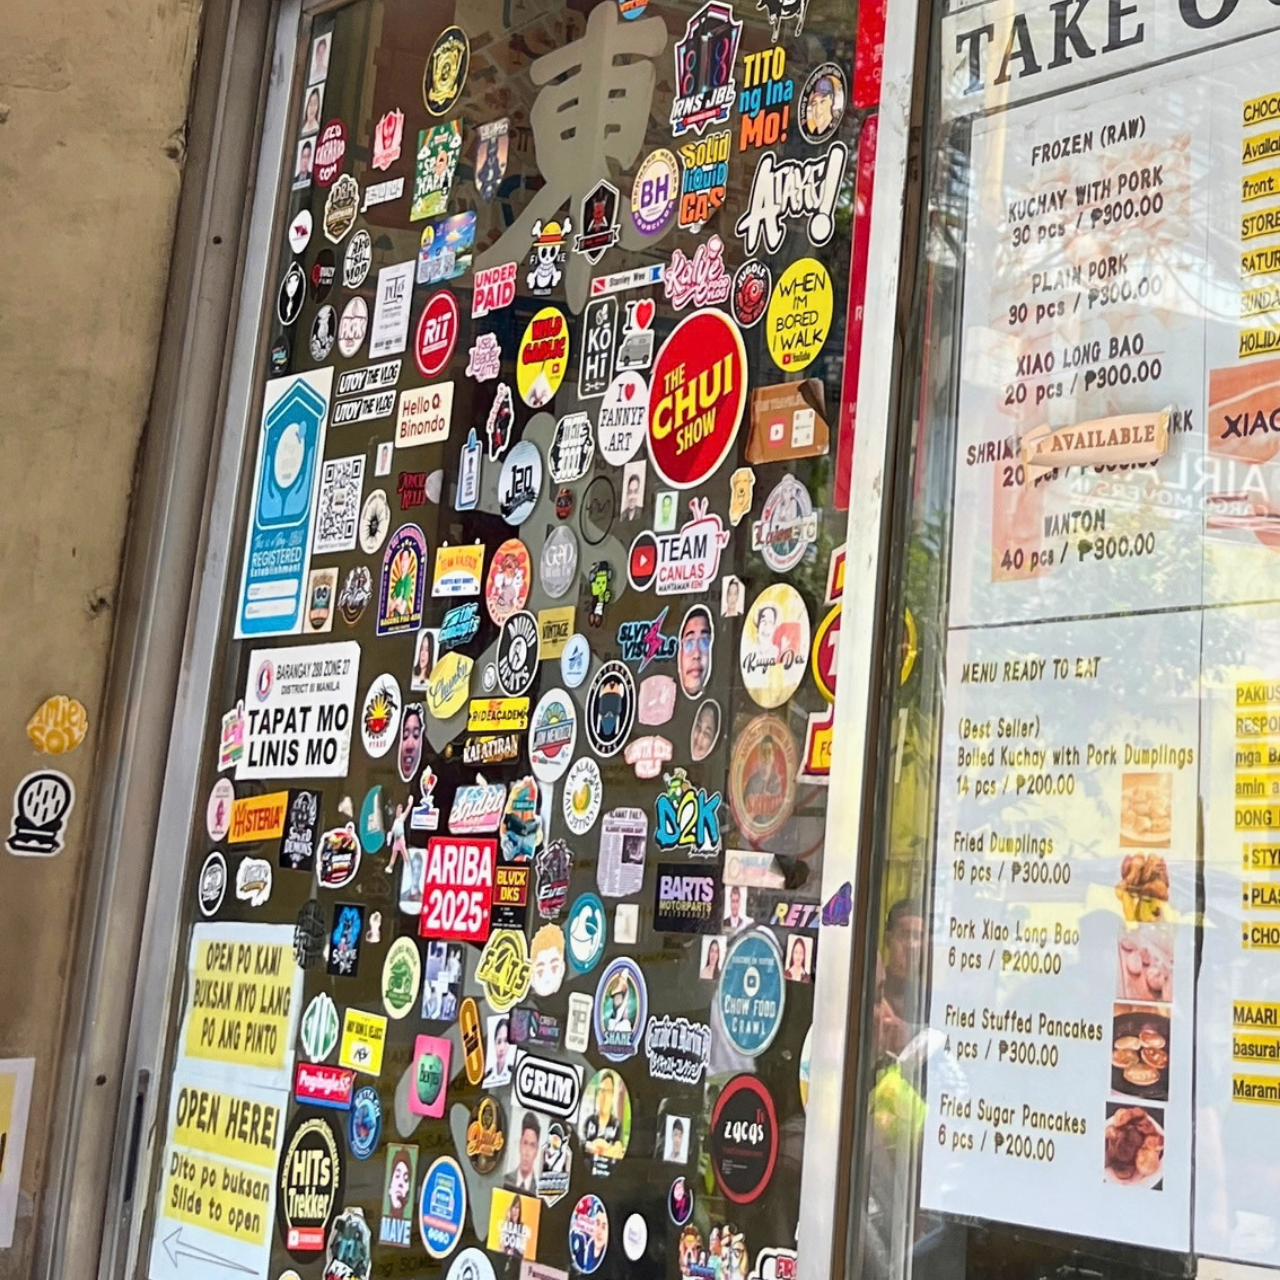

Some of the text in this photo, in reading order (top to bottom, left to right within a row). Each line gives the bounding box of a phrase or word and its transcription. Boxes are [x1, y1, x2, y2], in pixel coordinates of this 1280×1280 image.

[744, 47, 786, 88] TITO
[738, 79, 794, 116] ng Ina
[1031, 116, 1146, 166] FROZEN (RAW)
[1008, 165, 1163, 223] KUCHAY WITH PORK
[1242, 178, 1274, 198] front
[475, 263, 517, 288] UNDER
[779, 272, 826, 297] WHEN
[473, 282, 515, 313] PAID
[776, 311, 818, 332] BORED
[781, 328, 823, 351] WALK
[340, 364, 398, 393] UTOY THE VLOG
[664, 362, 685, 394] THE
[402, 396, 429, 417] Hello
[652, 353, 733, 440] CHUI
[400, 414, 445, 438] Binondo
[676, 410, 716, 455] SHOW
[1051, 425, 1155, 452] AVAILABLE
[660, 534, 707, 562] TEAM
[660, 563, 704, 582] CANLAS
[961, 656, 1101, 683] MENU READY TO EAT
[249, 704, 349, 735] TAPAT MO
[959, 715, 1040, 739] (Best Seller)
[248, 737, 337, 767] LINIS MO
[1001, 745, 1046, 768] Kuchay
[1053, 747, 1080, 764] with
[1087, 744, 1116, 764] Pork
[1125, 744, 1194, 769] Dumplings
[656, 791, 721, 846] D2K
[426, 844, 492, 887] ARIBA
[660, 876, 714, 901] BARTS
[660, 901, 712, 912] MOTORPARTS
[206, 942, 282, 975] OPEN PO KAMI
[194, 979, 290, 1017] BUKSAN NYO LANG
[724, 995, 775, 1018] CHOW FOOD
[732, 1020, 766, 1035] CRAWL
[945, 1004, 1103, 1041] Fried Stuffed Pancakes
[1233, 1007, 1277, 1025] MAARI
[201, 1017, 277, 1055] PO ANG PINTO
[520, 1070, 572, 1103] GRIM
[176, 1088, 220, 1135] OPEN
[940, 1093, 1086, 1134] Fried Sugar Pancakes
[170, 1152, 270, 1203] Dito po buksan
[171, 1184, 260, 1233] Slide to open
[289, 1187, 329, 1219] Trekker
